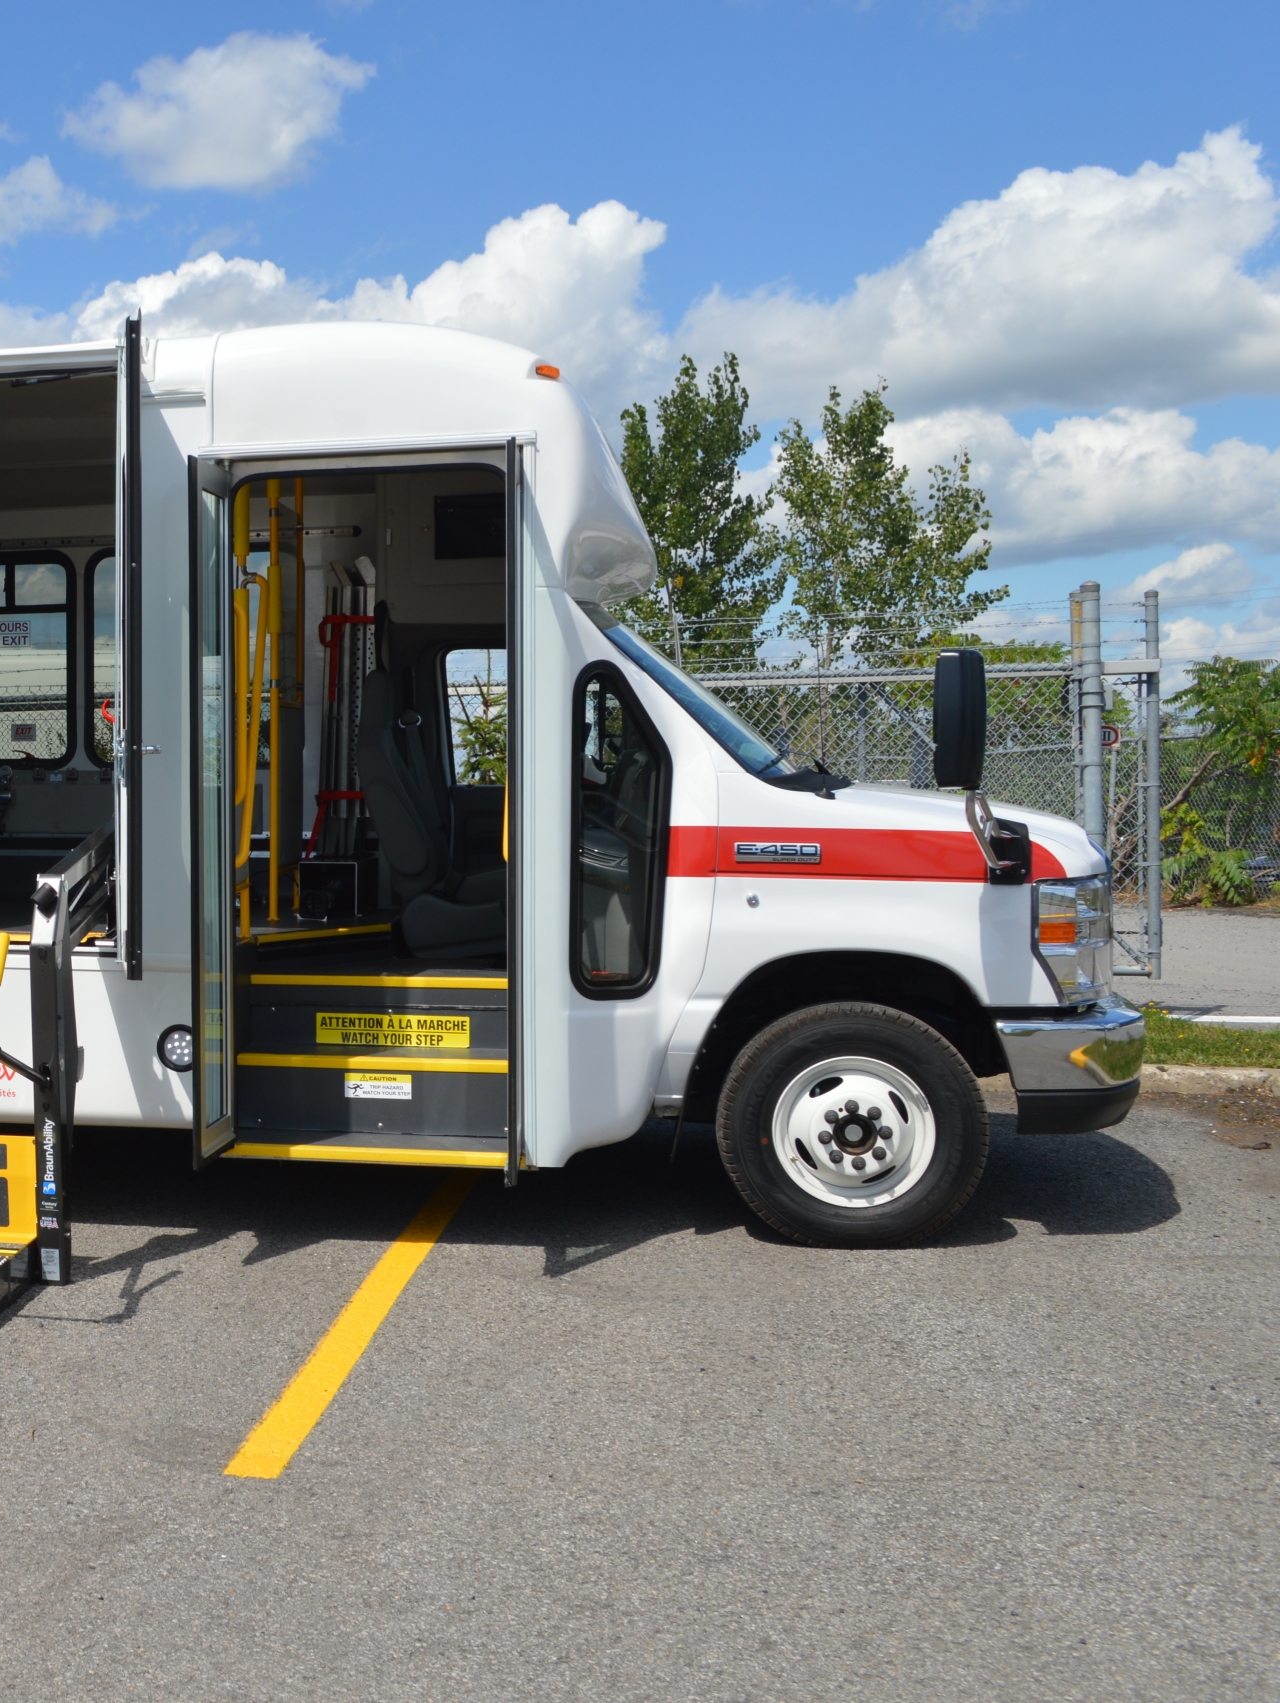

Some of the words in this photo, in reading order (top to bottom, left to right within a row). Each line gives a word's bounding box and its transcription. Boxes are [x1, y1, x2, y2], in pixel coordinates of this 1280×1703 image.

[2, 635, 28, 646] EXIT
[15, 727, 33, 735] EXIT
[736, 843, 818, 856] E-450
[320, 1016, 383, 1029] ATTENTION
[387, 1014, 395, 1030] À
[398, 1018, 413, 1030] LA
[417, 1019, 468, 1031] MARCHE
[341, 1031, 379, 1044] WATCH
[383, 1032, 413, 1045] YOUR
[416, 1034, 444, 1046] STEP
[43, 1119, 56, 1182] BraunAbility
[40, 1219, 59, 1229] USA
